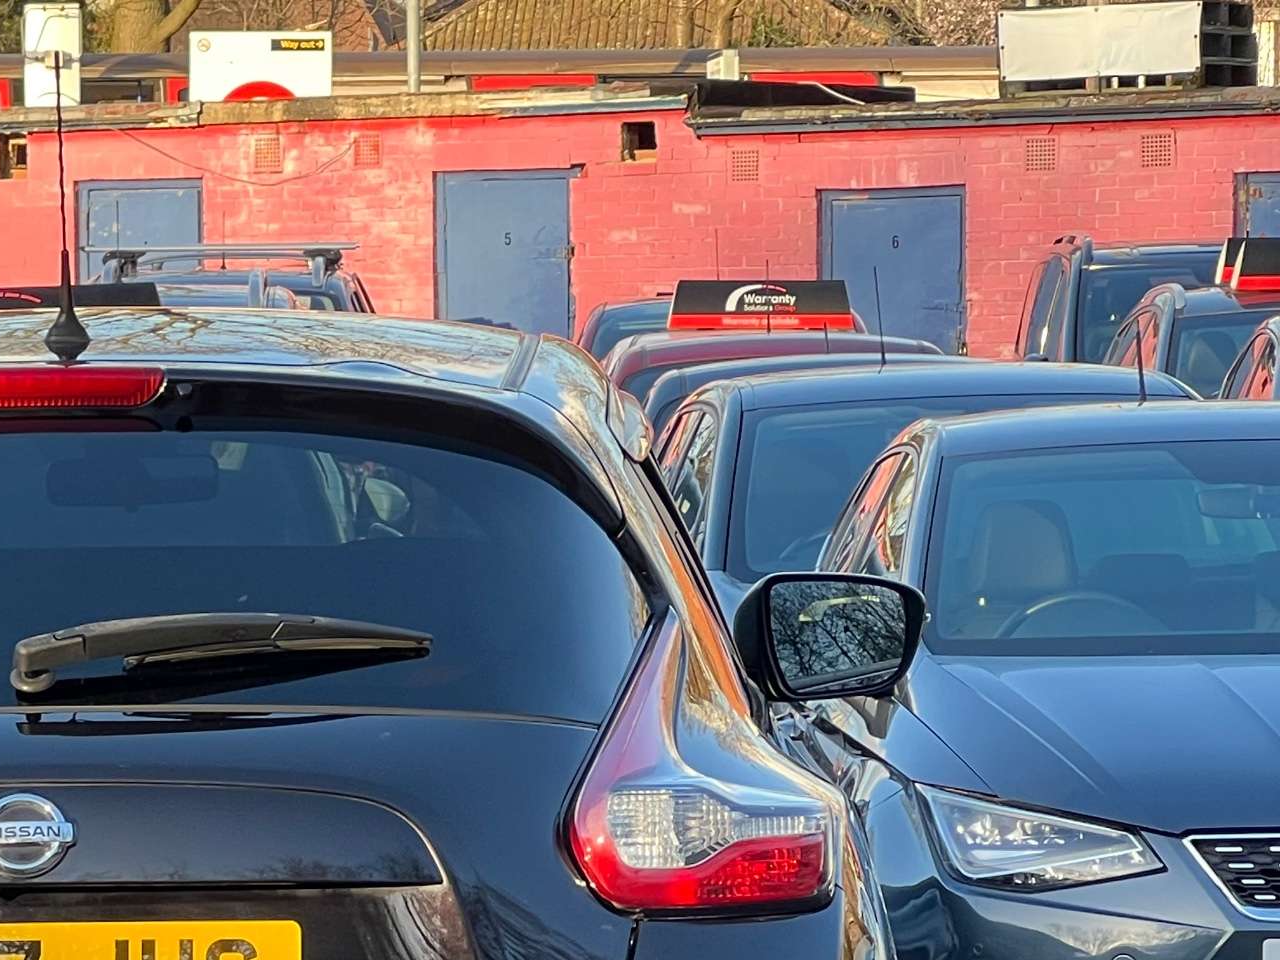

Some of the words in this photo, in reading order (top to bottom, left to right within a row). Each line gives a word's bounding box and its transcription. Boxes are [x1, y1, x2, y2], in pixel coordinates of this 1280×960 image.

[280, 40, 299, 50] Way
[300, 40, 315, 49] out
[504, 231, 512, 246] 5
[892, 235, 900, 249] 6
[743, 293, 797, 306] Warranty
